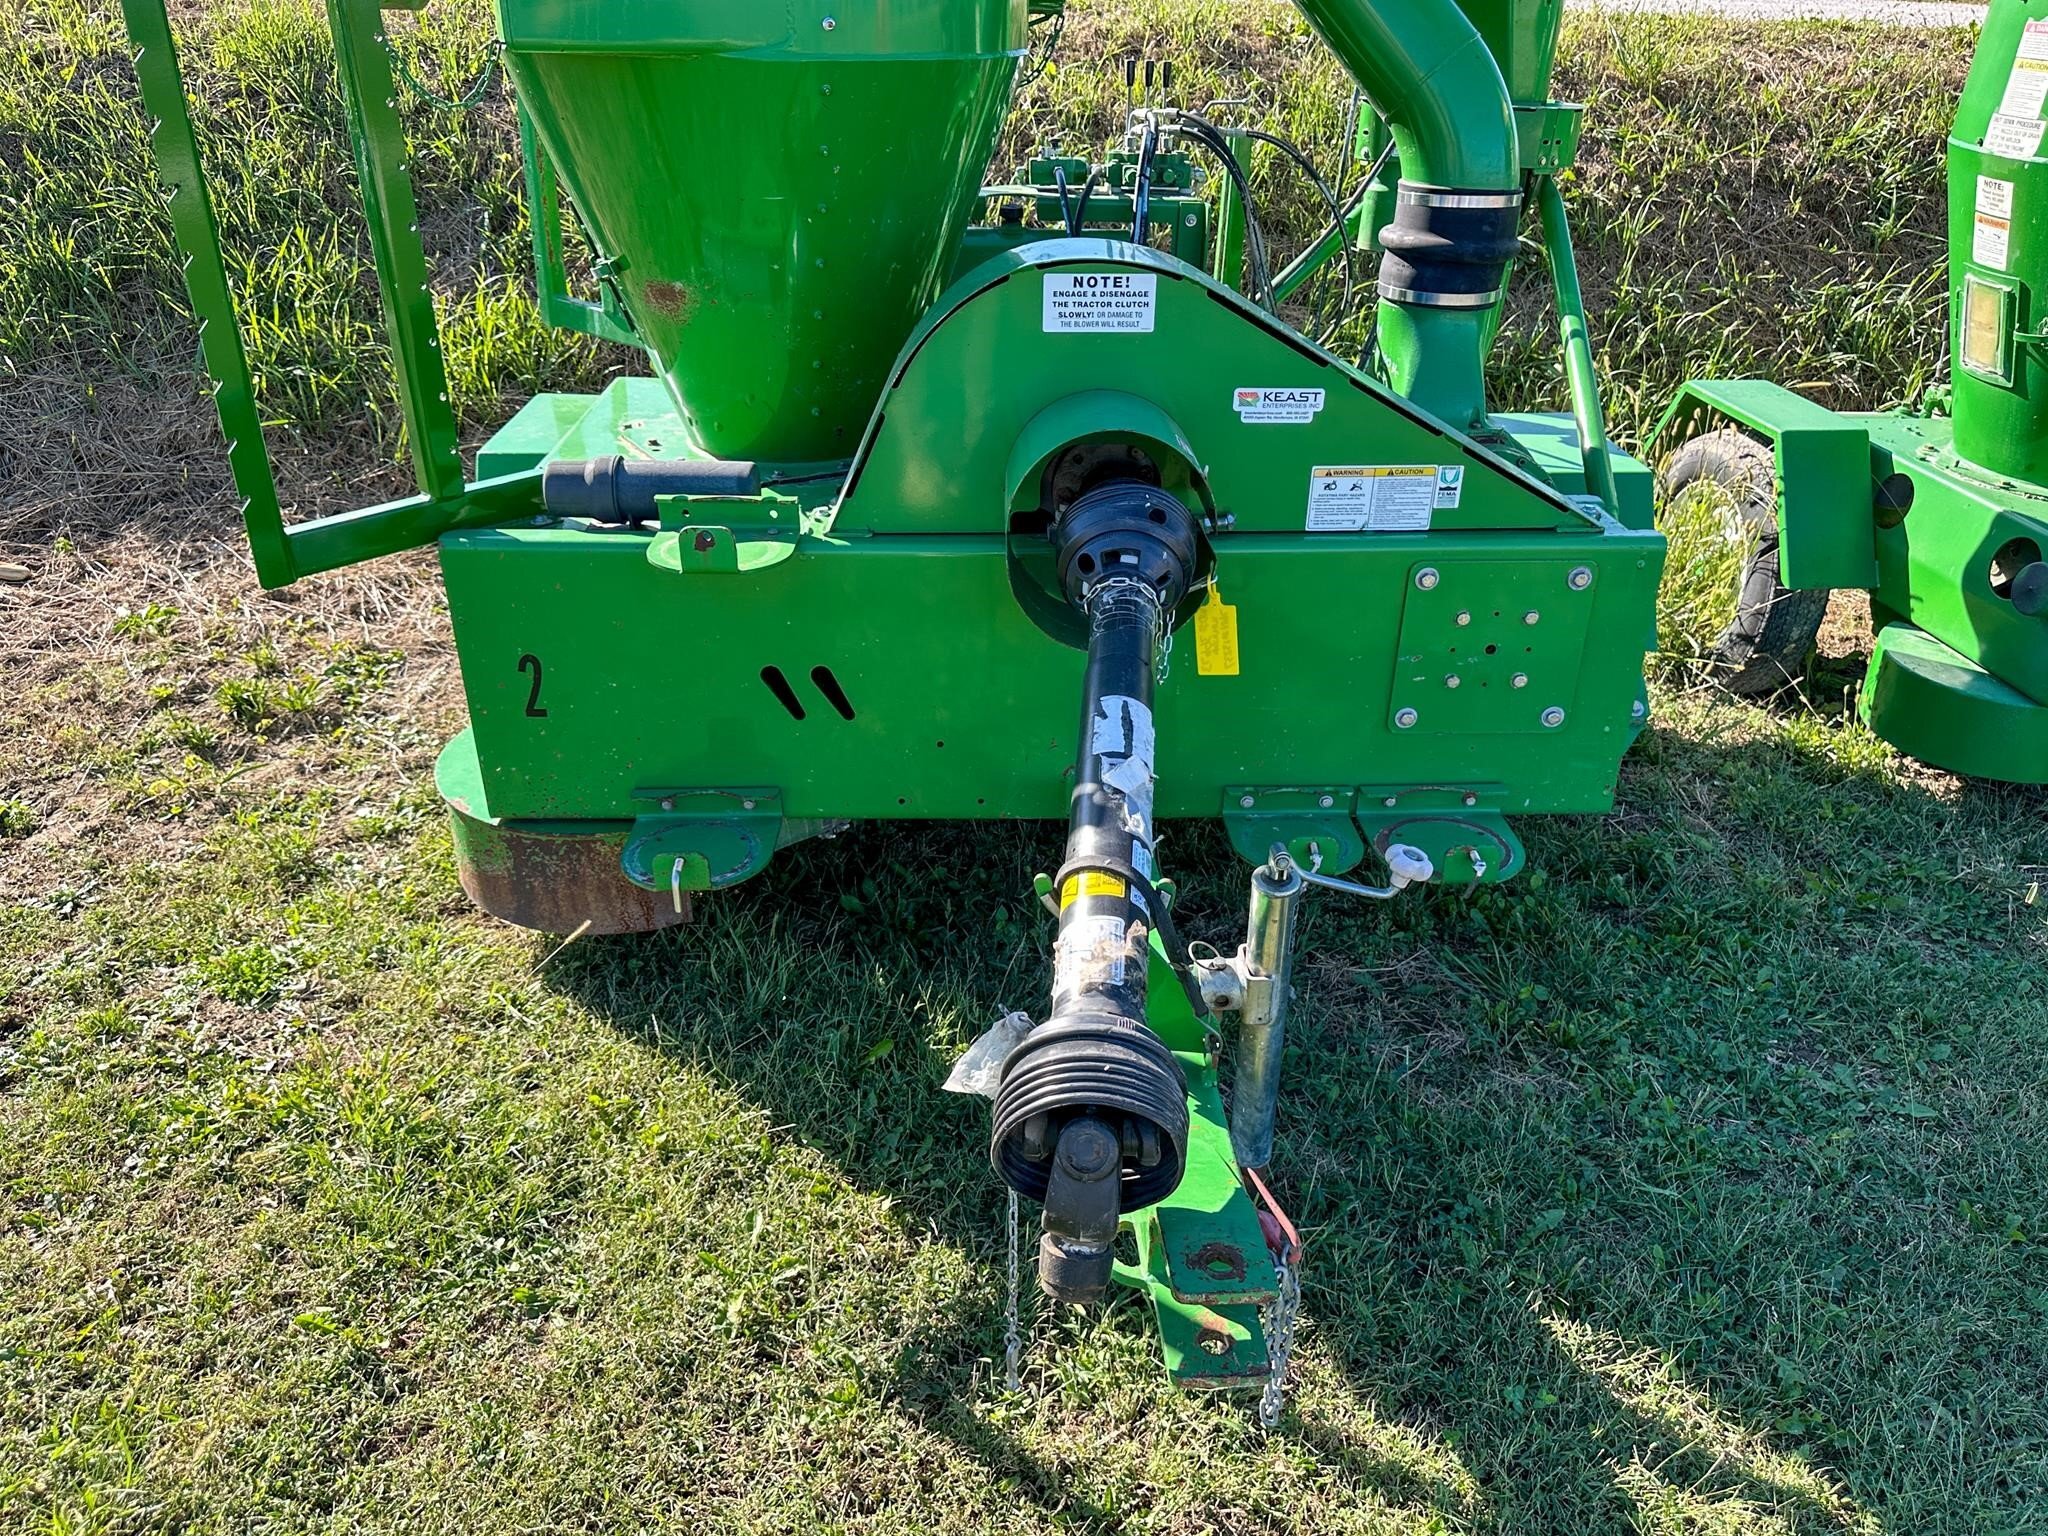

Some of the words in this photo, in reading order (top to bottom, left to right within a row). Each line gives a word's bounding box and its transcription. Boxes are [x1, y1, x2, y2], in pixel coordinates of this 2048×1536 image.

[1984, 180, 2004, 192] NOTE:
[1073, 276, 1130, 288] NOTE!
[1263, 392, 1321, 402] KEAST
[518, 654, 548, 717] 2
